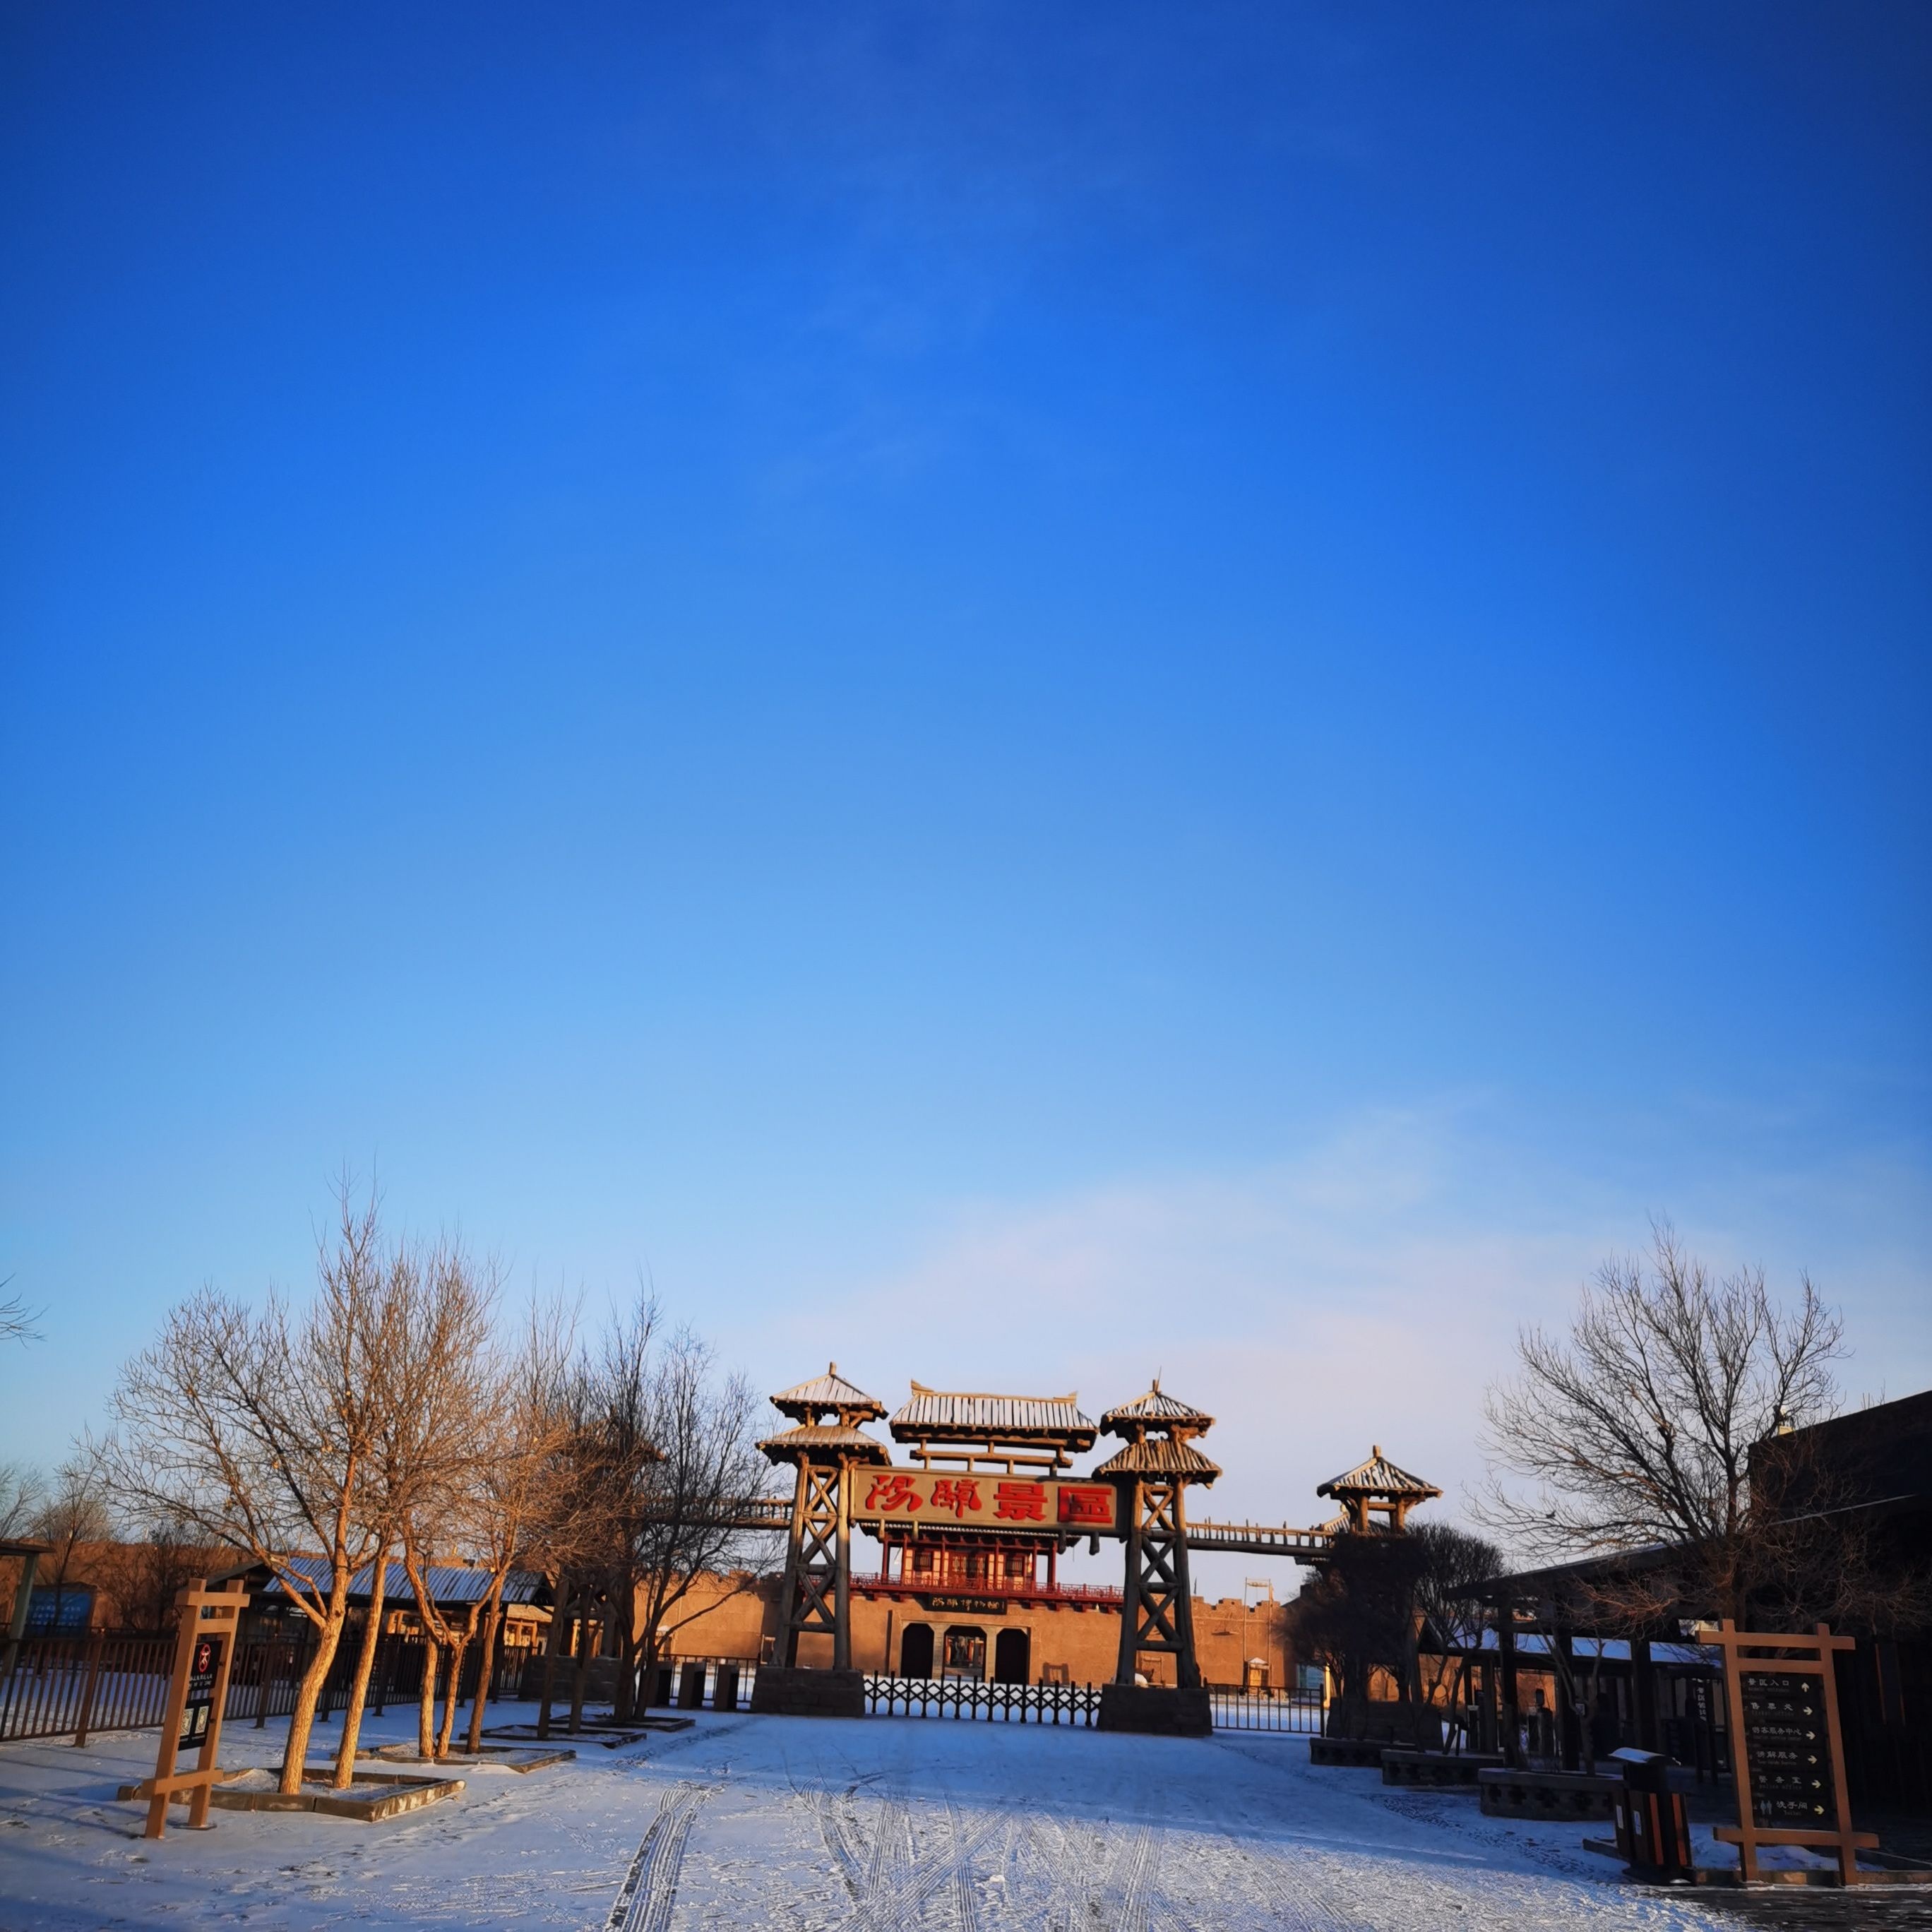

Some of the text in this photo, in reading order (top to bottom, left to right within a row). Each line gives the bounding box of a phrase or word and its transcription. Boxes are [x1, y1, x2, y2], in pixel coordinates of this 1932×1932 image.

[1751, 1726, 1802, 1735] 游客服务中心
[1776, 1800, 1808, 1810] 洗手间
